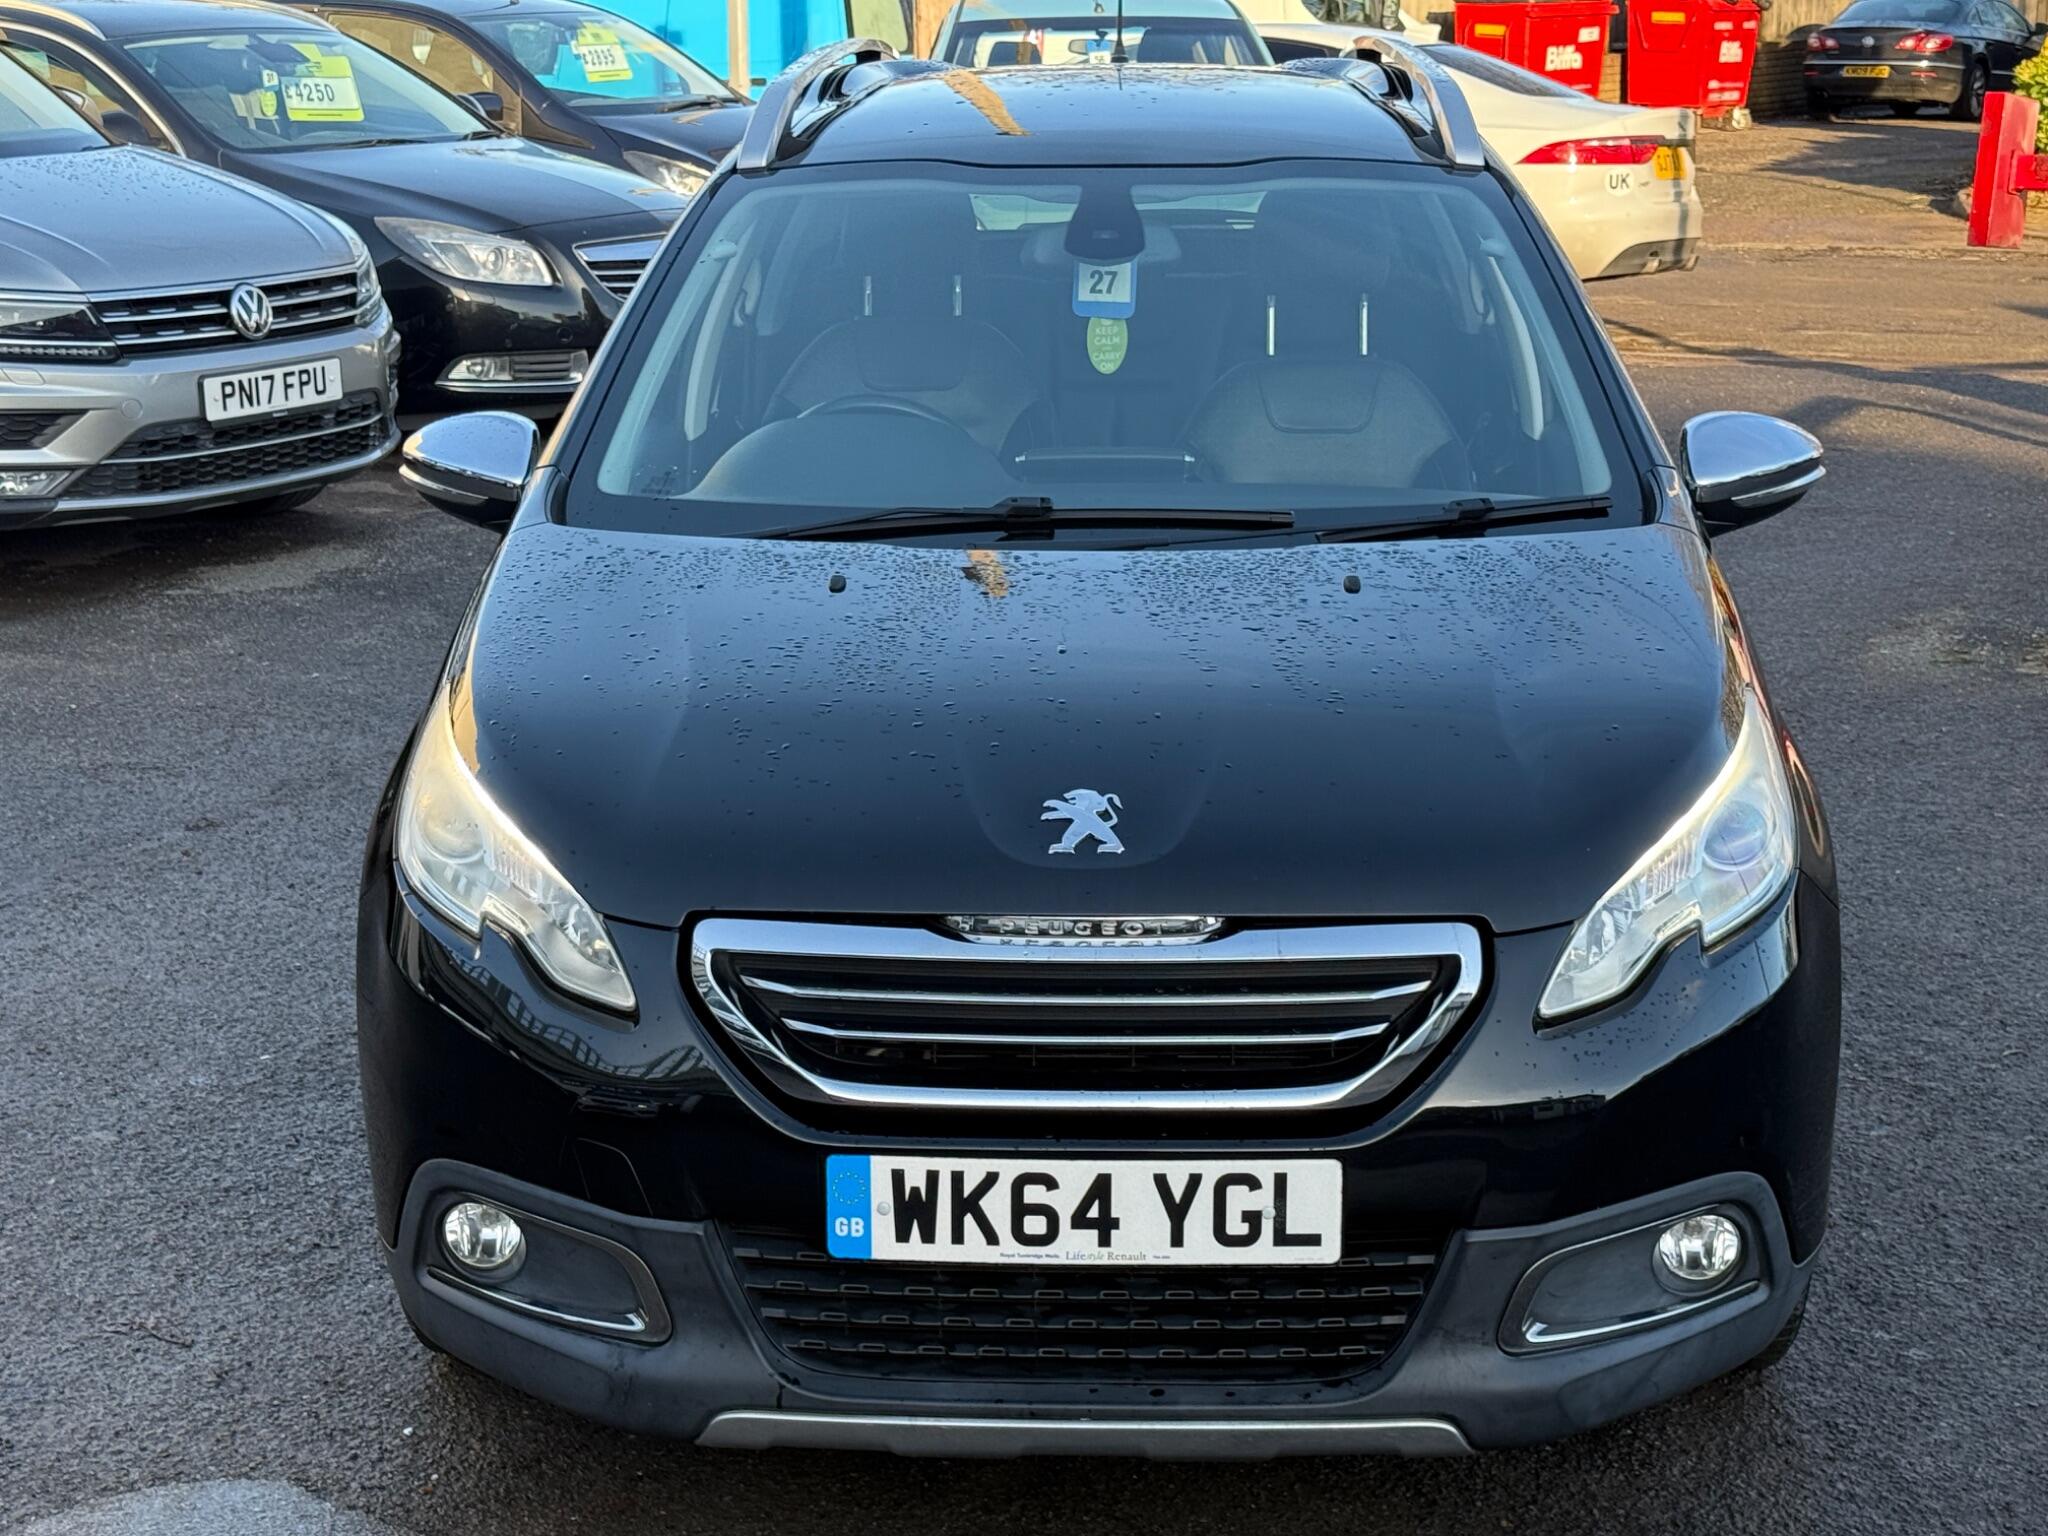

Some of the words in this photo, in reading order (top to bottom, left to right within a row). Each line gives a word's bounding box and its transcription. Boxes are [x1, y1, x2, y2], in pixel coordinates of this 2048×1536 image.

[284, 83, 335, 102] £4250
[1609, 173, 1630, 190] UK
[1089, 269, 1118, 295] 27
[1095, 326, 1119, 335] KEEP
[1094, 336, 1120, 345] CALM
[1100, 362, 1114, 370] ON
[220, 374, 275, 411] PN17
[283, 365, 327, 401] FPU
[1000, 918, 1168, 936] PEUGEOT
[891, 1168, 1120, 1248] WK64
[1152, 1172, 1322, 1248] YGL
[834, 1216, 865, 1237] GB
[1107, 1251, 1147, 1261] Renault
